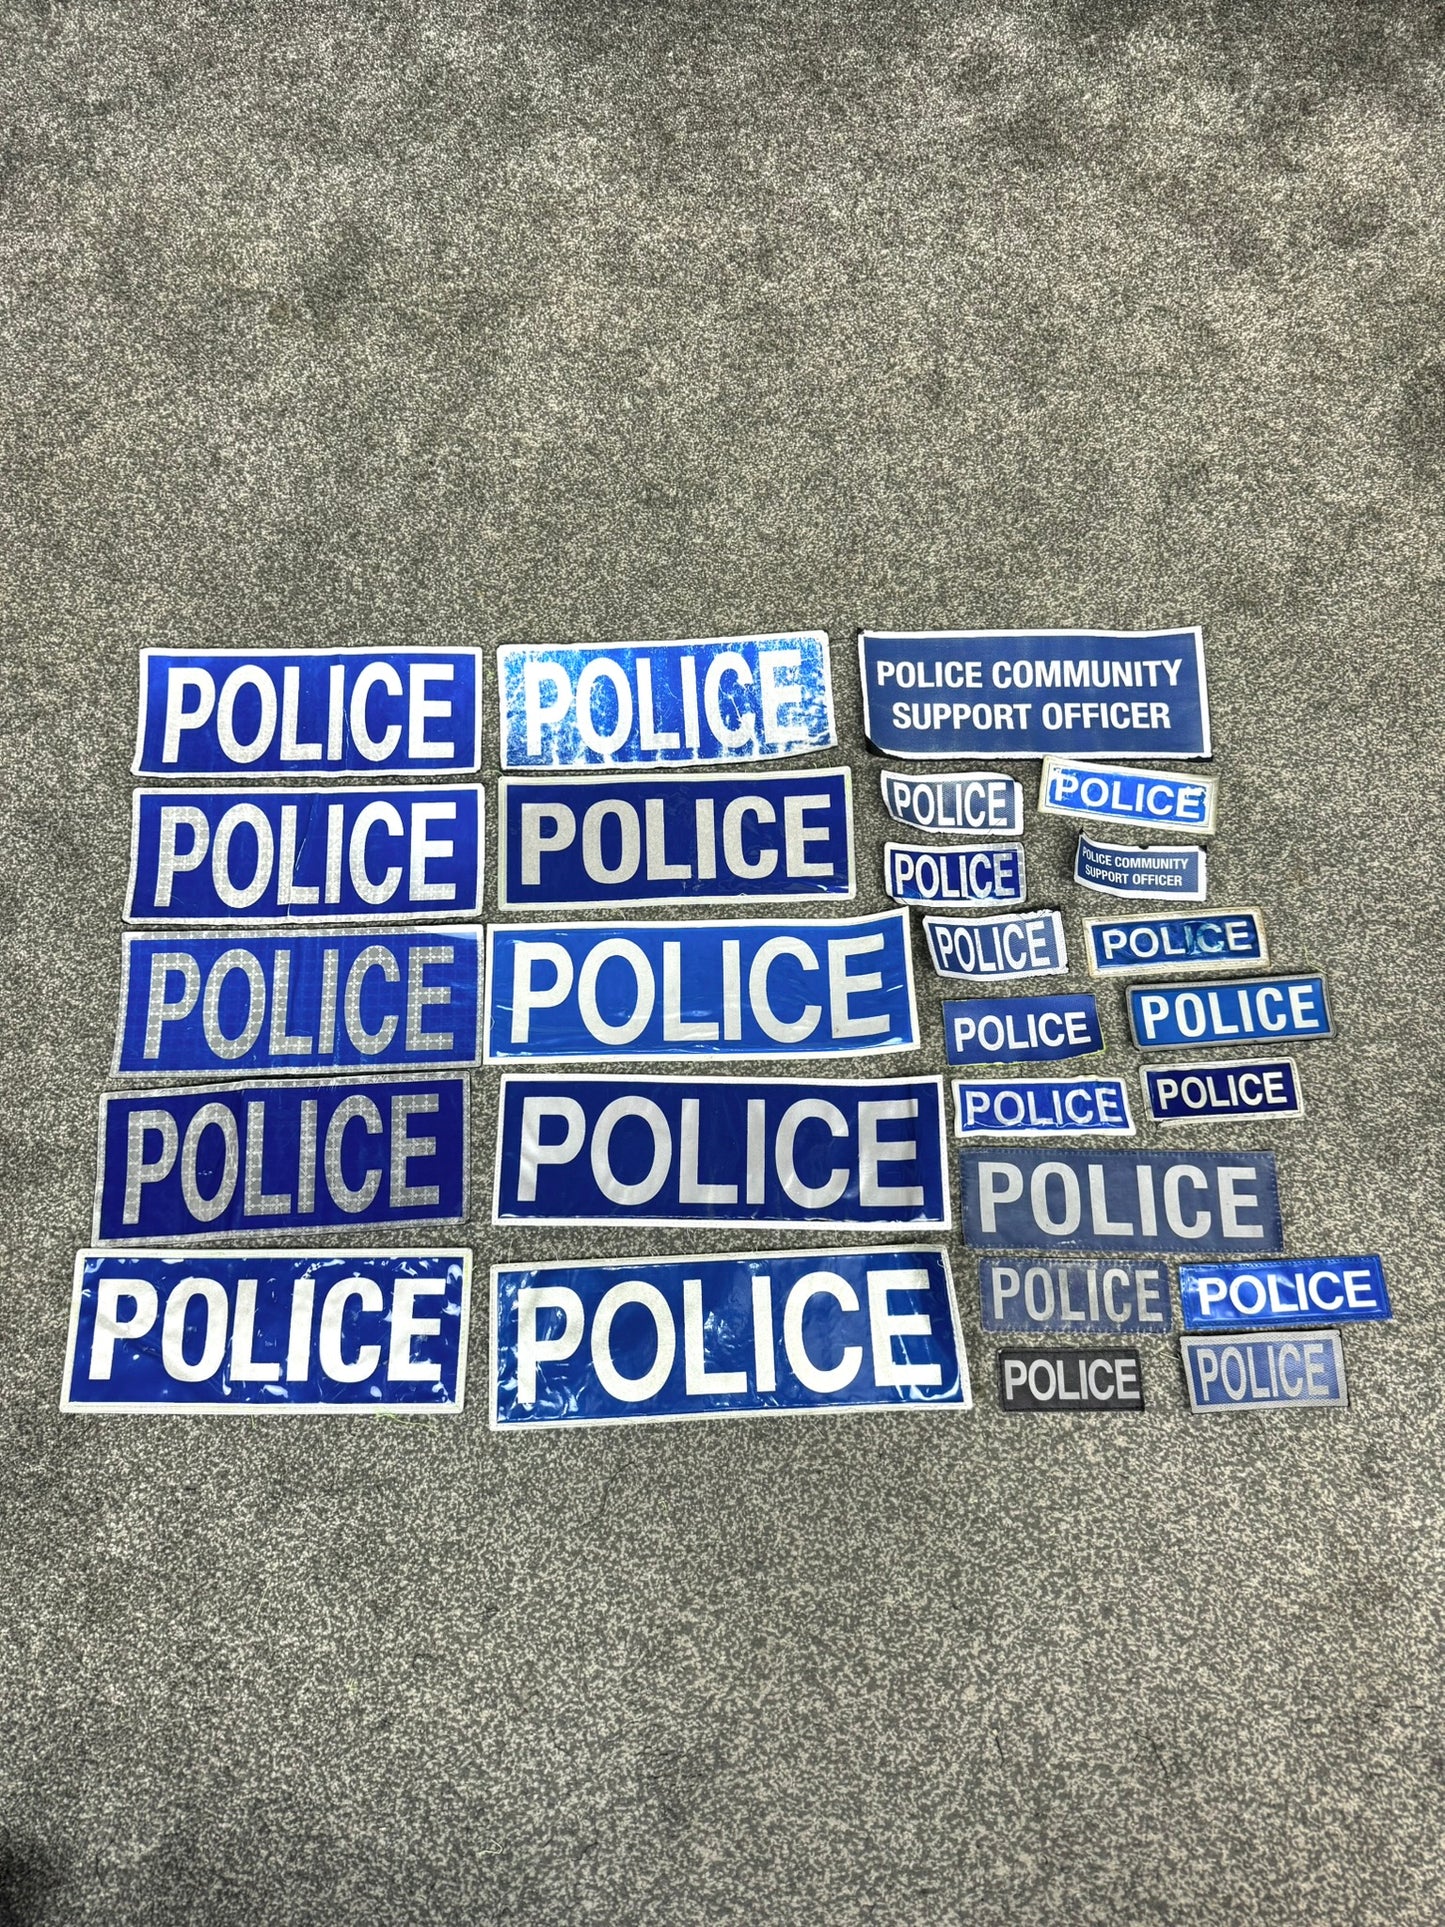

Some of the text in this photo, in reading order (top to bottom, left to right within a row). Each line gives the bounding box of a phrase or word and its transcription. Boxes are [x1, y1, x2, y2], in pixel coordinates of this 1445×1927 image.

[877, 659, 1182, 688] POLICE COMMUNITY
[162, 662, 455, 764] POLICE
[523, 648, 809, 756] POLICE
[892, 702, 1172, 730] SUPPORT OFFICER
[893, 780, 1007, 827] POLICE
[1051, 768, 1207, 819] POLICE
[153, 800, 457, 909] POLICE
[520, 794, 834, 885] POLICE
[1082, 847, 1189, 869] POLICE COMMUNITY
[894, 852, 1015, 899] POLICE
[1085, 864, 1182, 886] SUPPORT OFFICER
[936, 920, 1051, 972] POLICE
[1102, 920, 1252, 960] POLICE
[143, 944, 454, 1060] POLICE
[510, 933, 890, 1045] POLICE
[1140, 984, 1320, 1039] POLICE
[954, 1011, 1092, 1053] POLICE
[966, 1087, 1124, 1128] POLICE
[1156, 1071, 1288, 1110] POLICE
[122, 1093, 440, 1222] POLICE
[517, 1095, 924, 1209] POLICE
[977, 1160, 1264, 1239] POLICE
[991, 1266, 1164, 1322] POLICE
[1198, 1270, 1377, 1315] POLICE
[89, 1277, 447, 1383] POLICE
[517, 1269, 942, 1404] POLICE
[1004, 1358, 1140, 1400] POLICE
[1197, 1343, 1329, 1401] POLICE
